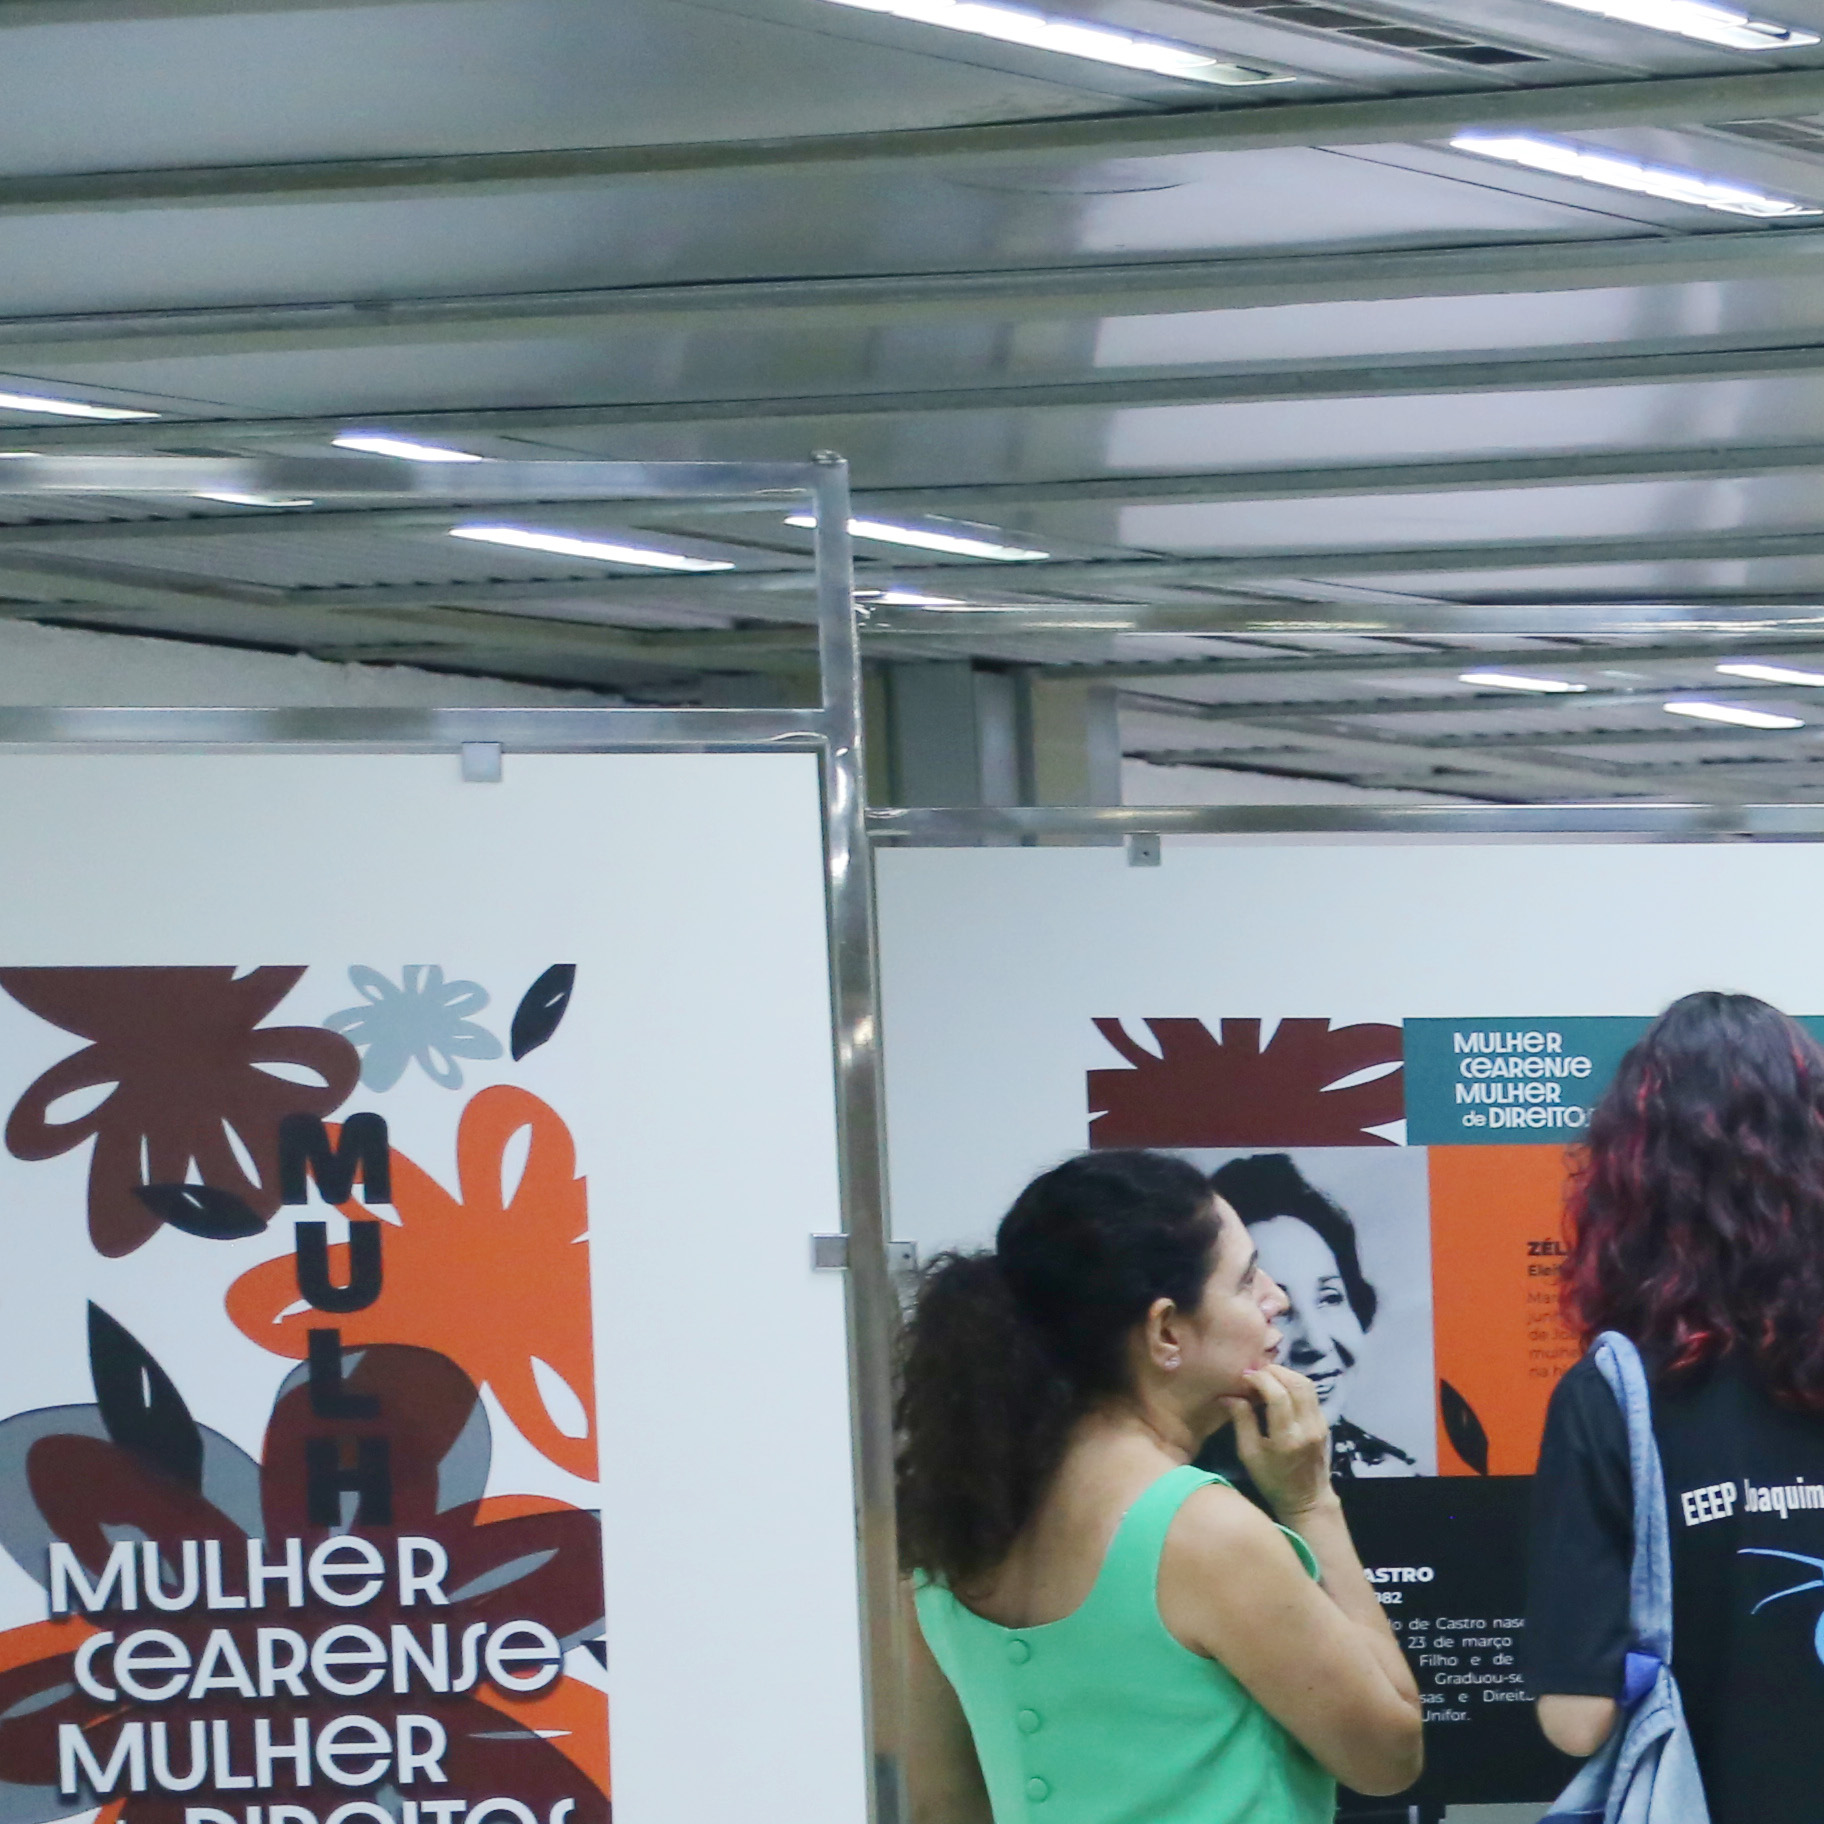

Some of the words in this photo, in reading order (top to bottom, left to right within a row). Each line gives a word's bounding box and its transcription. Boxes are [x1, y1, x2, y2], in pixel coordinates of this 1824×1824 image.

[1462, 1110, 1487, 1127] de
[1681, 1481, 1737, 1527] EEEP
[1363, 1567, 1434, 1583] ASTRO
[1408, 1618, 1430, 1630] de
[1436, 1617, 1487, 1629] Castro
[1408, 1636, 1427, 1648] 23
[1433, 1636, 1454, 1648] de
[1462, 1637, 1513, 1650] março
[1419, 1654, 1458, 1666] Filho
[1470, 1656, 1481, 1666] e
[1493, 1653, 1514, 1665] de
[1434, 1672, 1524, 1685] Graduou-se
[1458, 1693, 1469, 1702] e
[1483, 1690, 1535, 1702] Direit
